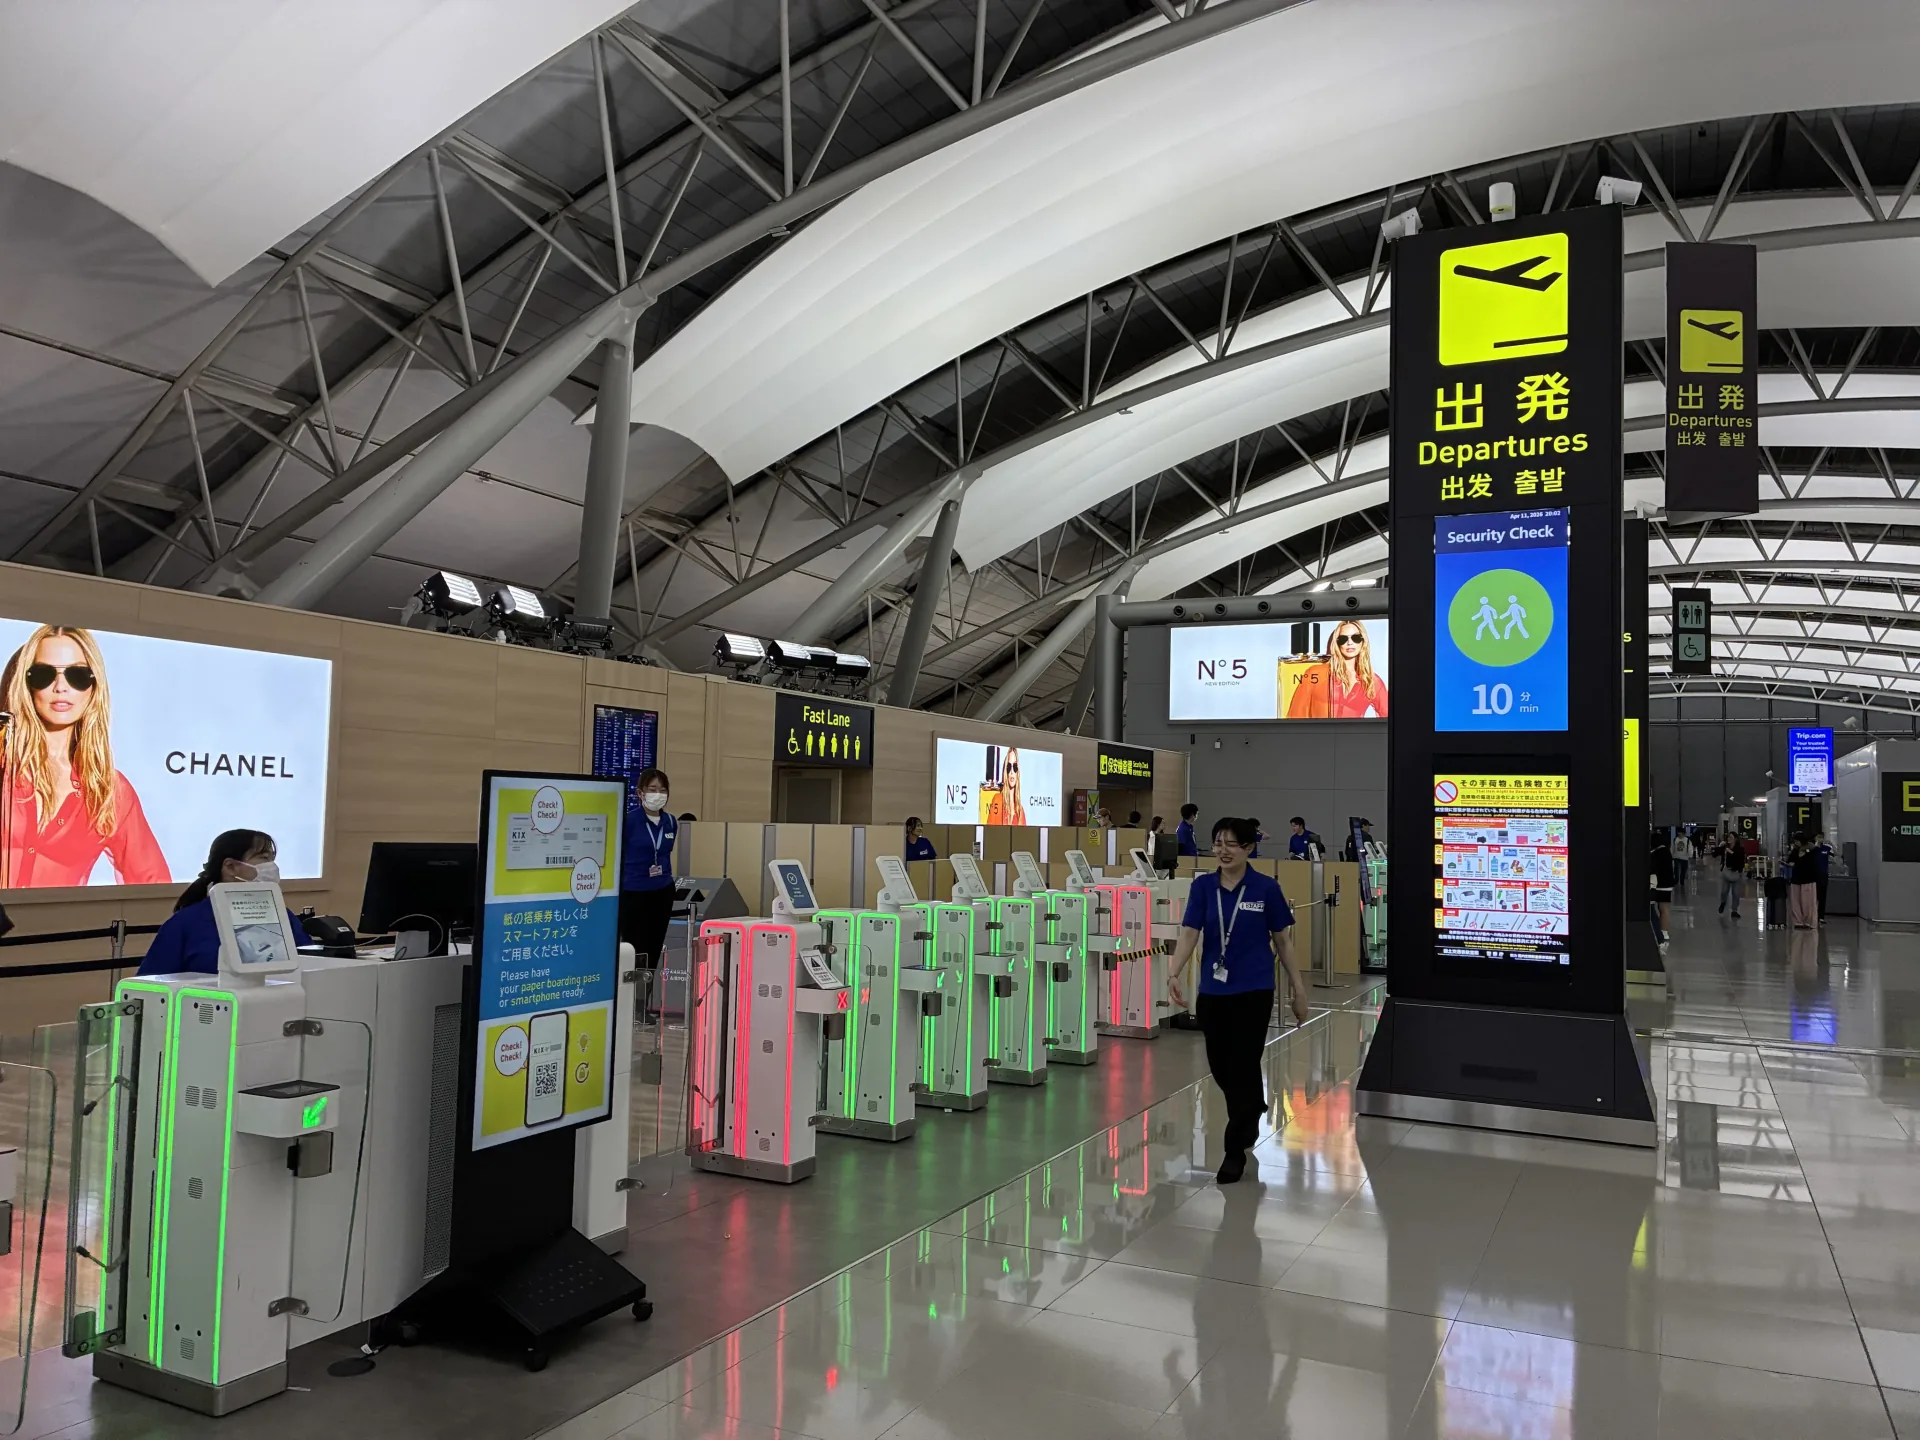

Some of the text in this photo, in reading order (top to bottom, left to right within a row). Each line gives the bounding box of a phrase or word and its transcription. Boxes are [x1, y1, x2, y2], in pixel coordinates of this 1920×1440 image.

[1435, 371, 1570, 431] 出発
[1677, 384, 1745, 411] 出発
[1670, 414, 1753, 430] Departures
[1677, 432, 1746, 447] 出发 출발
[1418, 433, 1588, 468] Departures
[1440, 467, 1566, 500] 出发 출발
[1448, 525, 1554, 544] Security Check
[1472, 683, 1513, 715] 10
[1520, 692, 1531, 702] 分
[803, 706, 850, 727] Fast Lane
[1520, 704, 1538, 713] min
[165, 750, 294, 780] CHANEL
[1030, 796, 1054, 807] CHANEL
[1743, 818, 1752, 829] G
[1798, 807, 1810, 824] F
[504, 908, 588, 926] 紙の搭乗券もしくは
[503, 926, 578, 943] スマートフォンを
[502, 944, 574, 962] ご用意ください。
[500, 968, 550, 982] Please have
[500, 974, 600, 997] your paper boarding pass
[499, 987, 585, 1007] or smartphone ready.
[501, 1041, 522, 1052] Check!
[500, 1052, 522, 1062] Check!
